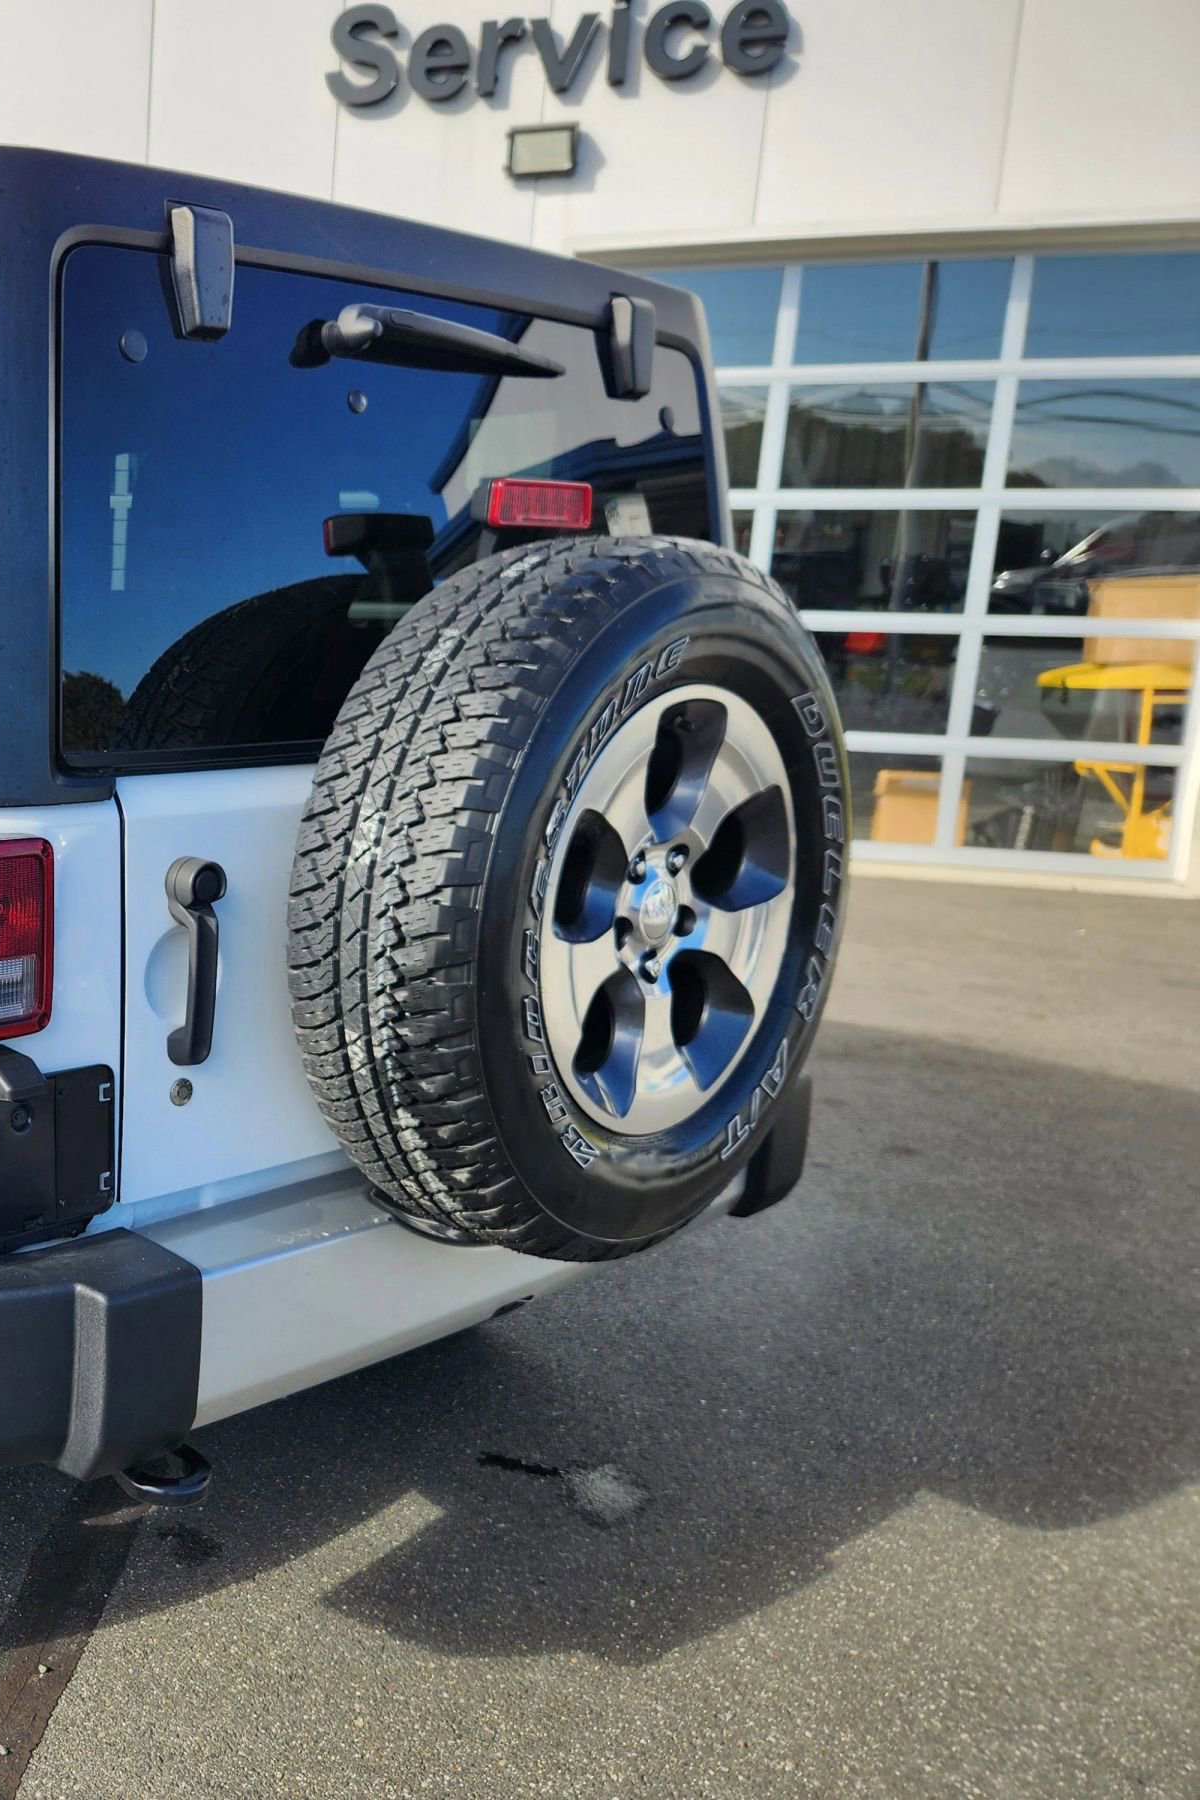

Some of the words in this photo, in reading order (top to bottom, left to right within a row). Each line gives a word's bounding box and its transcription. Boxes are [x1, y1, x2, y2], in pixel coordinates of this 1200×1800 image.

[325, 0, 790, 107] Service
[518, 636, 690, 1168] BRIDGESTONE
[792, 692, 843, 1022] DUELER
[721, 1037, 787, 1160] A/T
